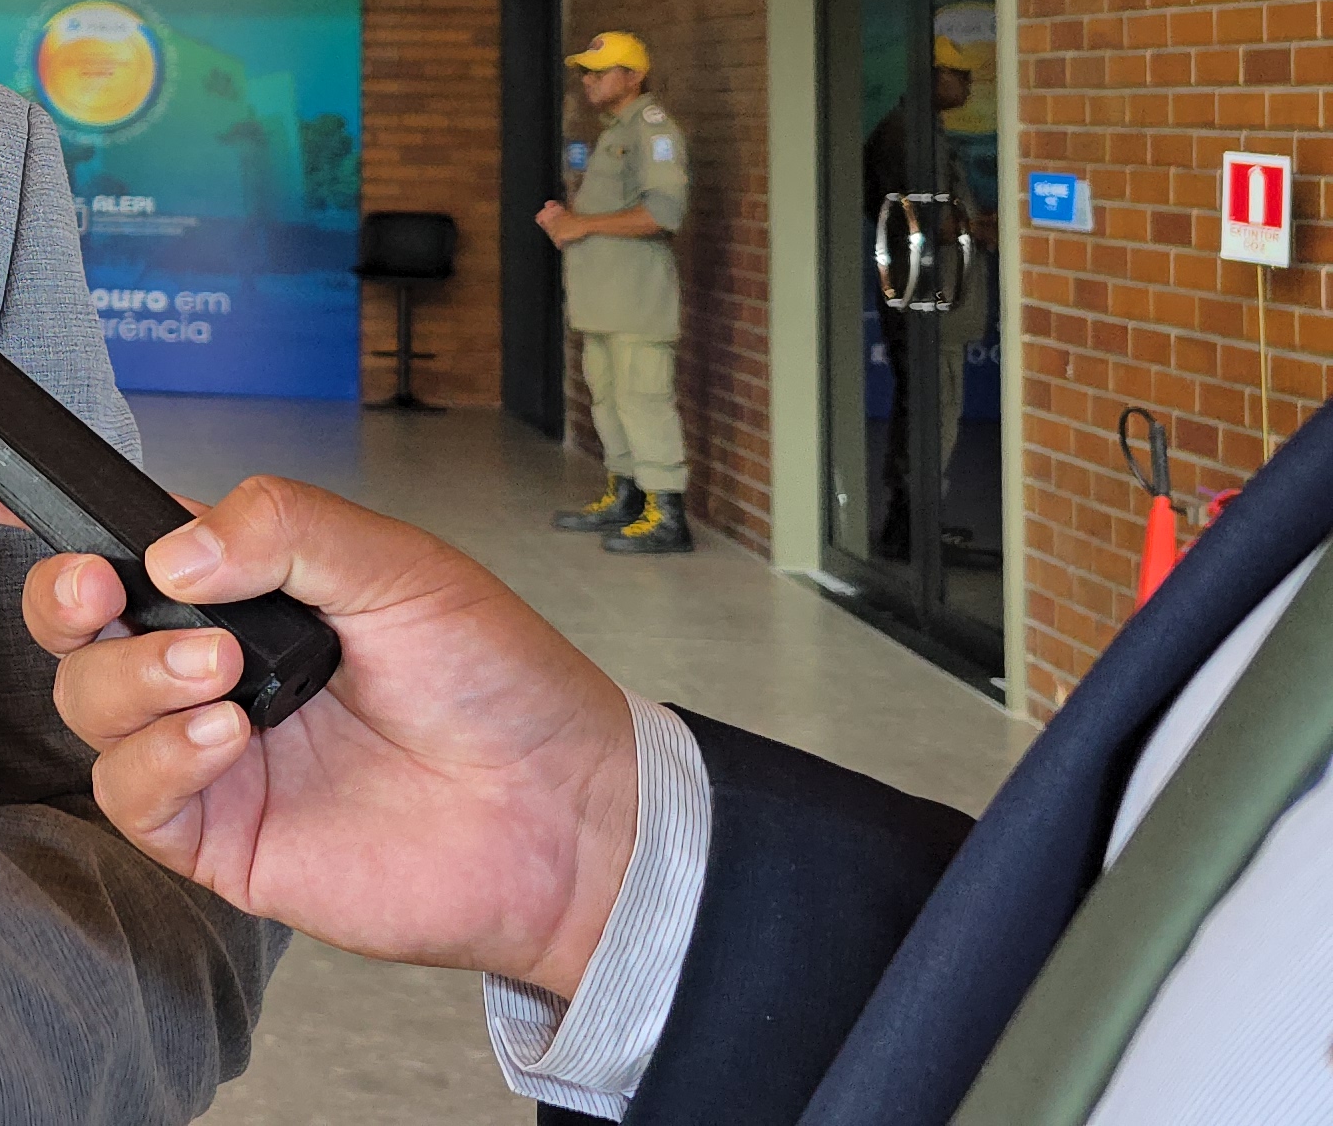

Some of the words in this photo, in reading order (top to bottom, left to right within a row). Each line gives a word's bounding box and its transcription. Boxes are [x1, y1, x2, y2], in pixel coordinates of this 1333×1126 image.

[91, 194, 156, 215] ALEPI
[174, 290, 232, 315] em
[100, 311, 213, 344] rência
